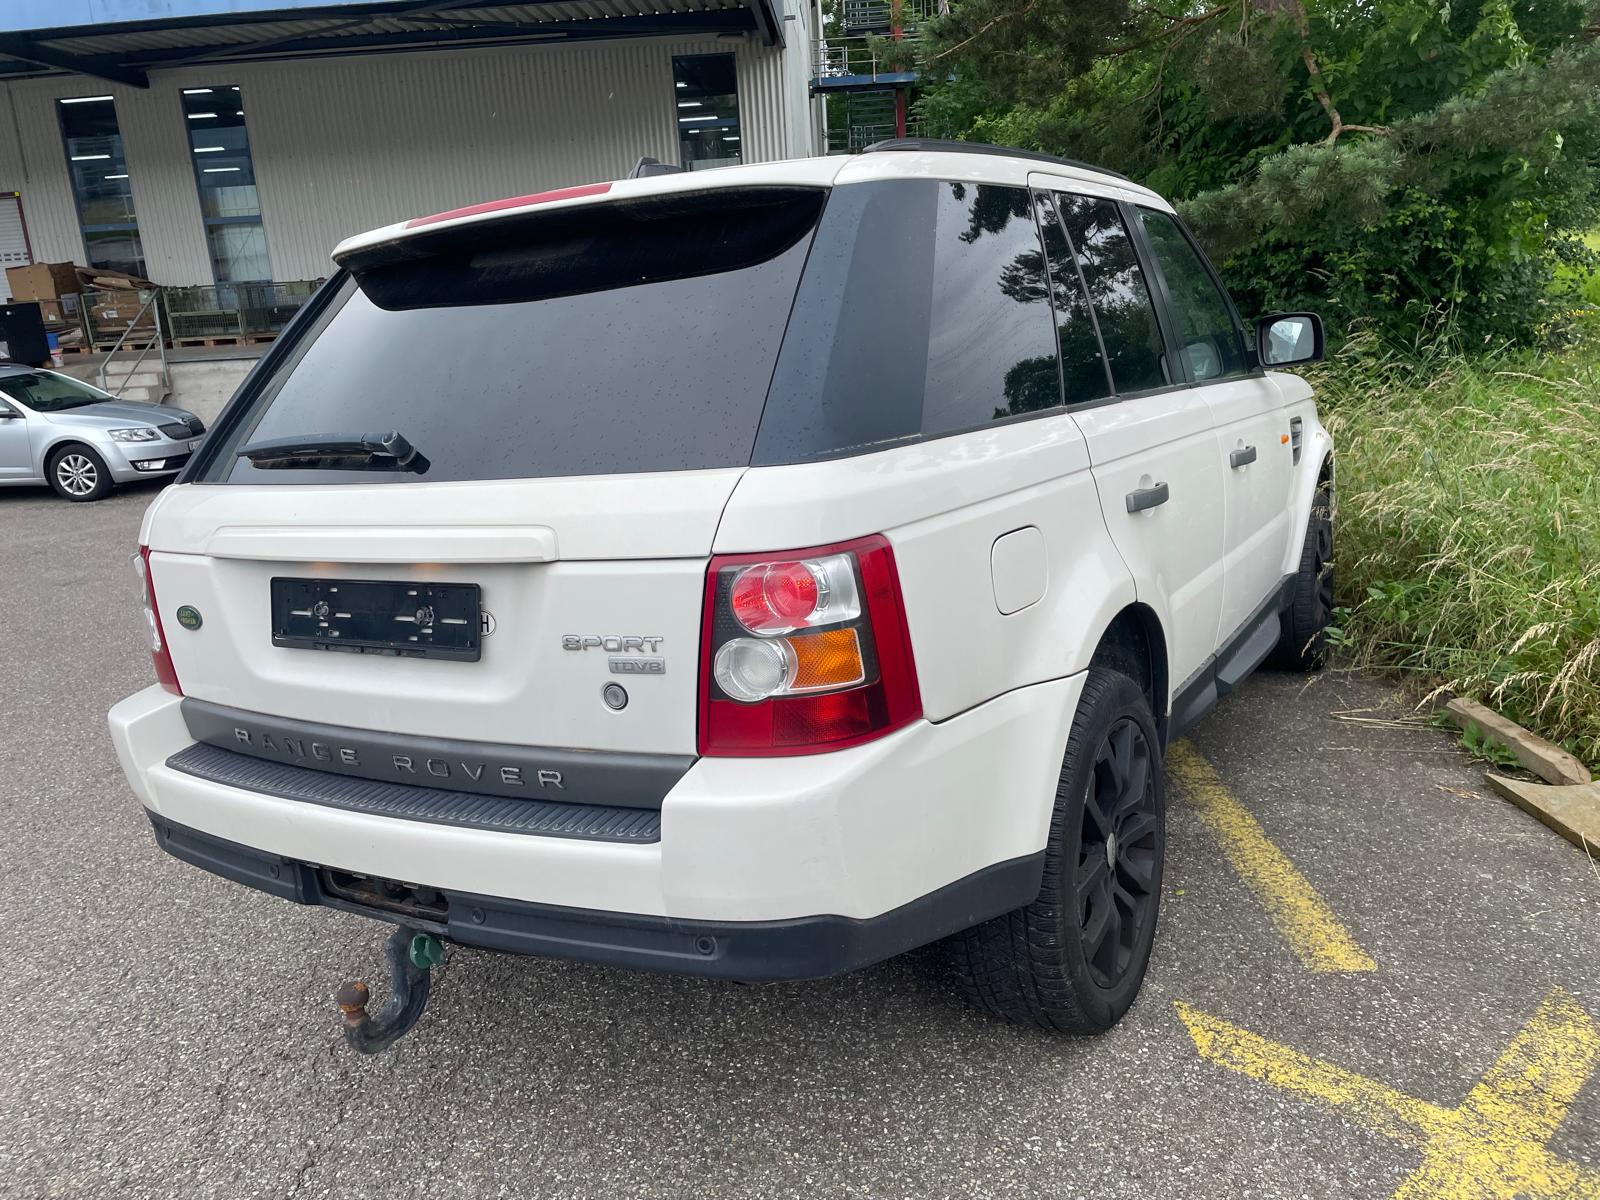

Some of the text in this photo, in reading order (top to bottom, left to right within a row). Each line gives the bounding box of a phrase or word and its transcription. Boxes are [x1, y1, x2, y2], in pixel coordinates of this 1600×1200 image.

[561, 634, 664, 653] SPORT
[611, 661, 663, 673] TDV8
[234, 727, 566, 790] RANGE ROVER
